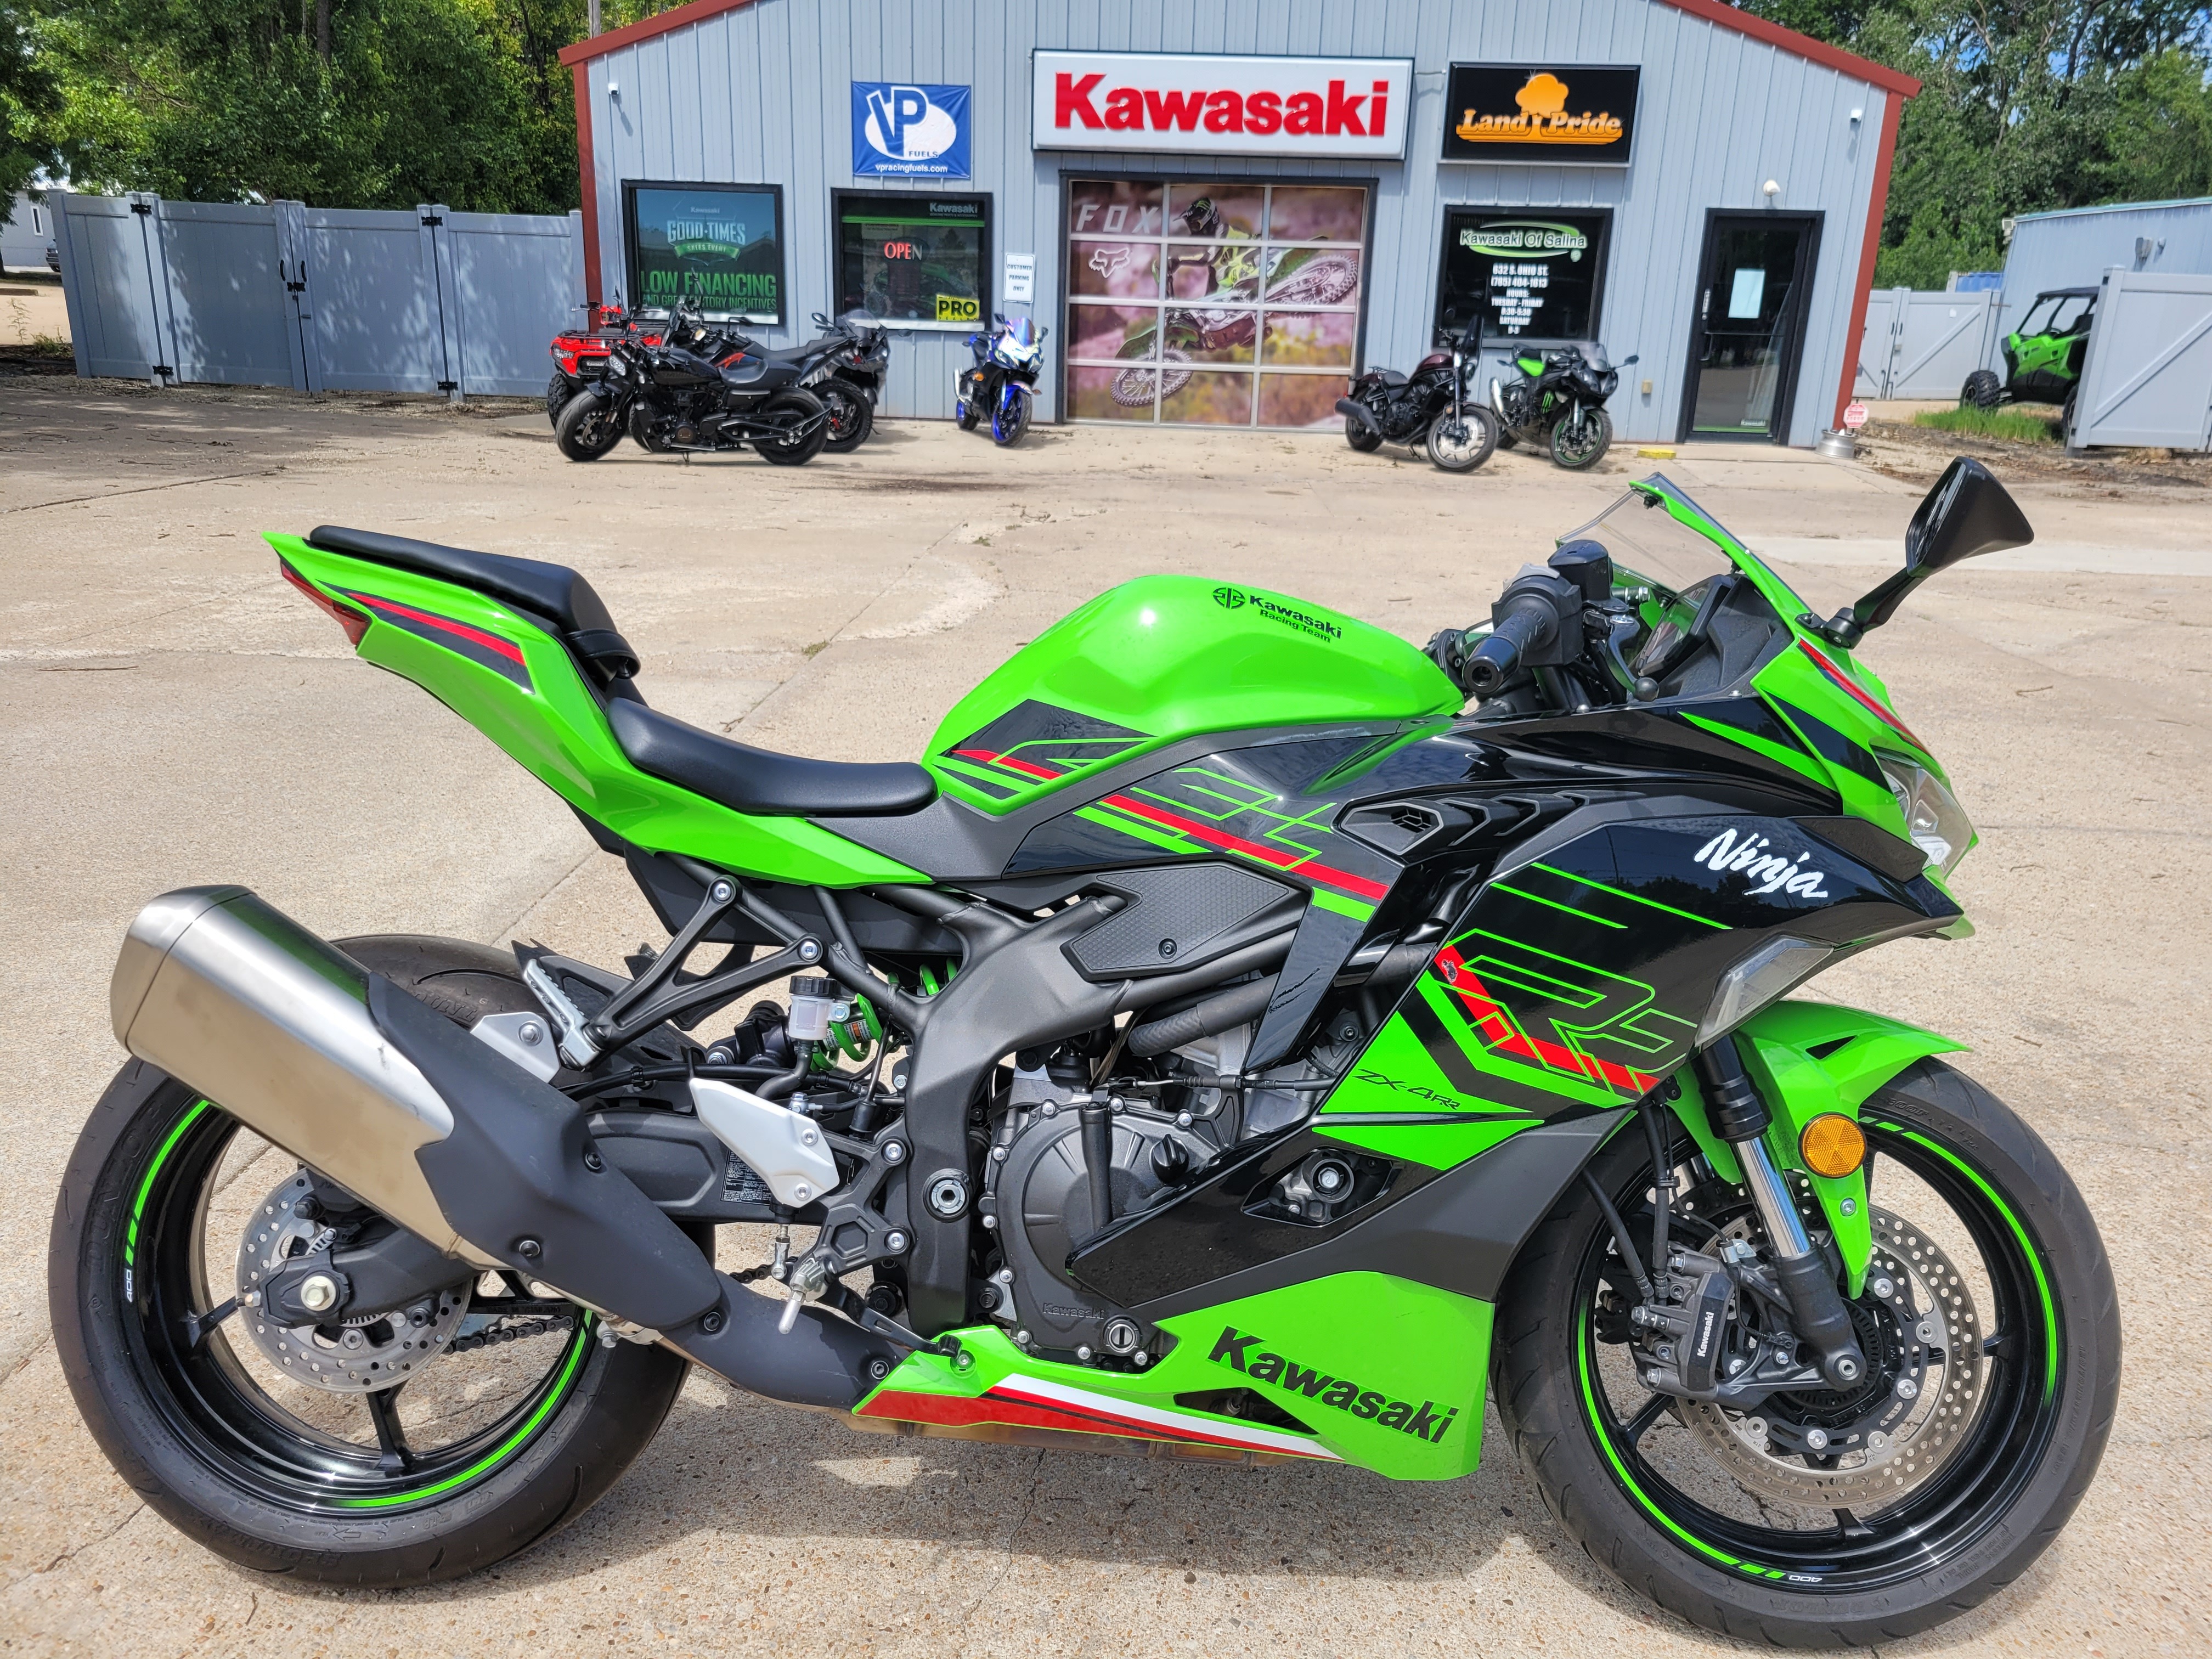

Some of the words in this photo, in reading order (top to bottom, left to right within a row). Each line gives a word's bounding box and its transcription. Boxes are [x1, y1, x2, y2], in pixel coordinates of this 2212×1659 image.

[1055, 72, 1389, 137] Kawasaki
[867, 87, 928, 157] VP
[1460, 109, 1528, 133] Land
[1547, 111, 1621, 136] Pride
[875, 164, 948, 173] vpracingfuels.com
[930, 202, 978, 213] Kawasaki
[1076, 205, 1162, 234] FOX
[667, 220, 703, 242] GOOD
[707, 222, 746, 245] TIMES
[1460, 229, 1521, 246] Kawasaki
[1525, 230, 1543, 247] Of
[1544, 232, 1587, 248] Salina
[884, 242, 923, 261] OPEN
[1517, 263, 1537, 276] OHIO
[640, 271, 678, 294] LOW
[684, 272, 777, 297] FINANCING
[729, 297, 777, 310] INCENTIVES
[939, 300, 977, 317] PRO
[1491, 296, 1518, 307] TUESDAY
[1521, 297, 1544, 307] FRIDAY
[1499, 315, 1531, 325] SATURDAY
[1250, 595, 1342, 640] Kawasaki
[1260, 609, 1299, 630] Racing
[1301, 624, 1331, 644] Team
[1694, 828, 1828, 898] Ninja
[1352, 1069, 1460, 1110] ZX-4RR
[1043, 1302, 1105, 1319] Kawasaki
[1697, 1311, 1714, 1357] Kawasaki
[1207, 1326, 1459, 1444] Kawasaki
[1788, 1575, 1823, 1583] 400
